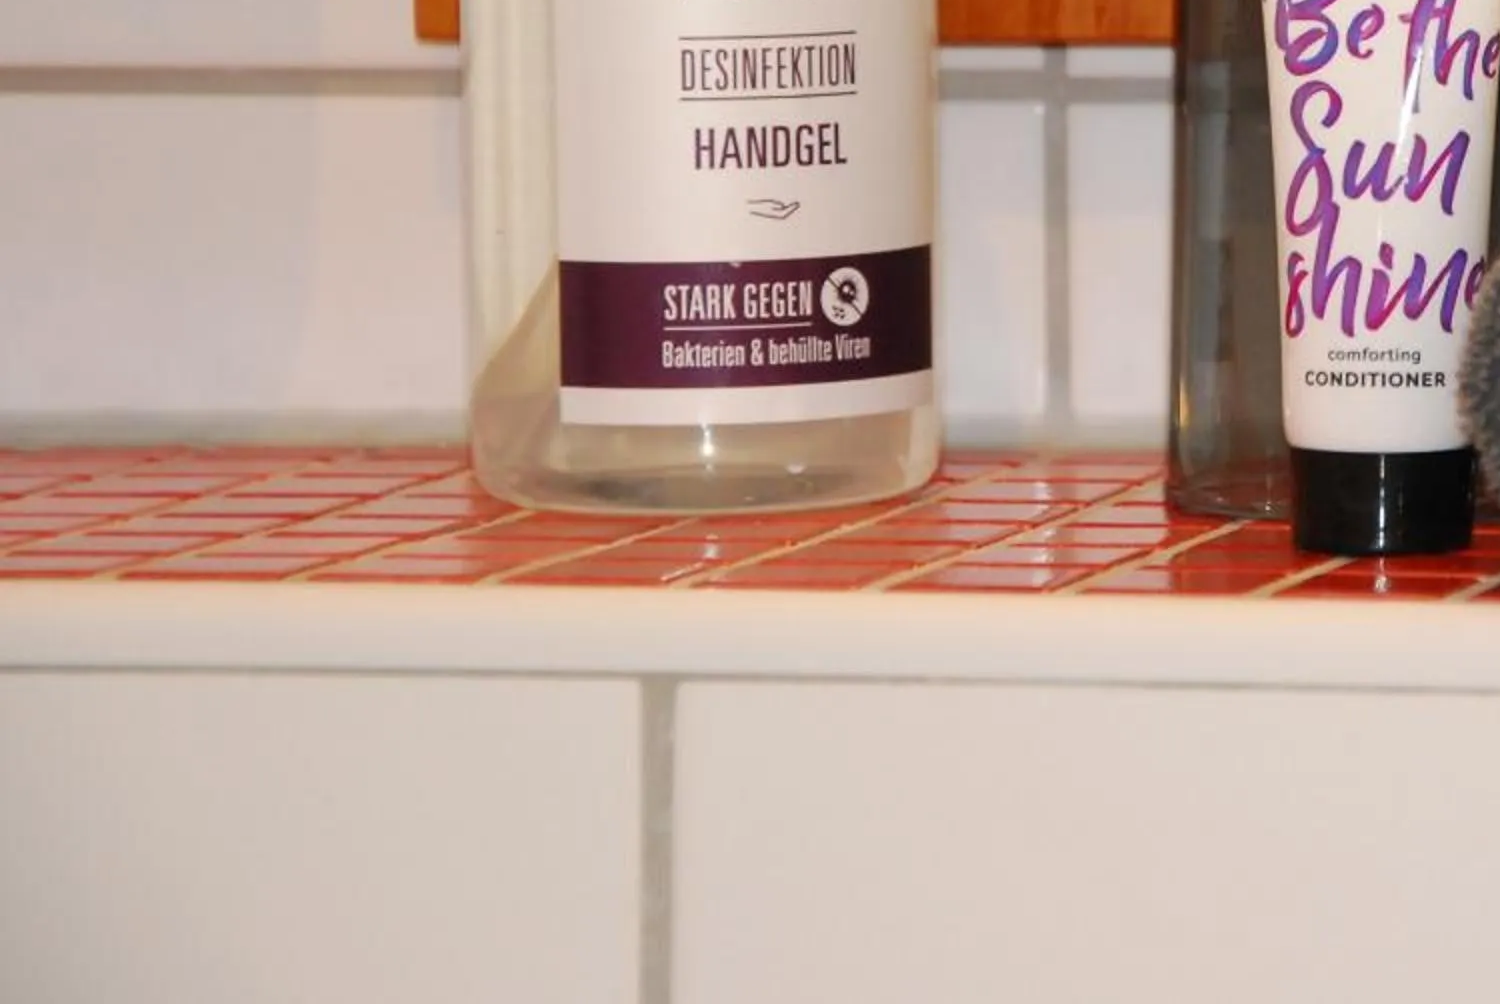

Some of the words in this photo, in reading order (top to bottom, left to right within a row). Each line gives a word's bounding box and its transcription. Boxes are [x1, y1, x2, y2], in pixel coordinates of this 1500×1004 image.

[680, 42, 857, 92] DESINFEKTION
[693, 122, 848, 171] HANDGEL
[1285, 79, 1471, 236] Sun
[663, 283, 737, 321] STARK
[743, 280, 813, 319] GEGEN
[661, 339, 746, 369] Bakterien
[750, 338, 765, 367] &
[769, 335, 833, 366] behüllte
[835, 333, 871, 362] Viren
[1327, 347, 1422, 365] comforting
[1304, 371, 1447, 388] CONDITIONER
